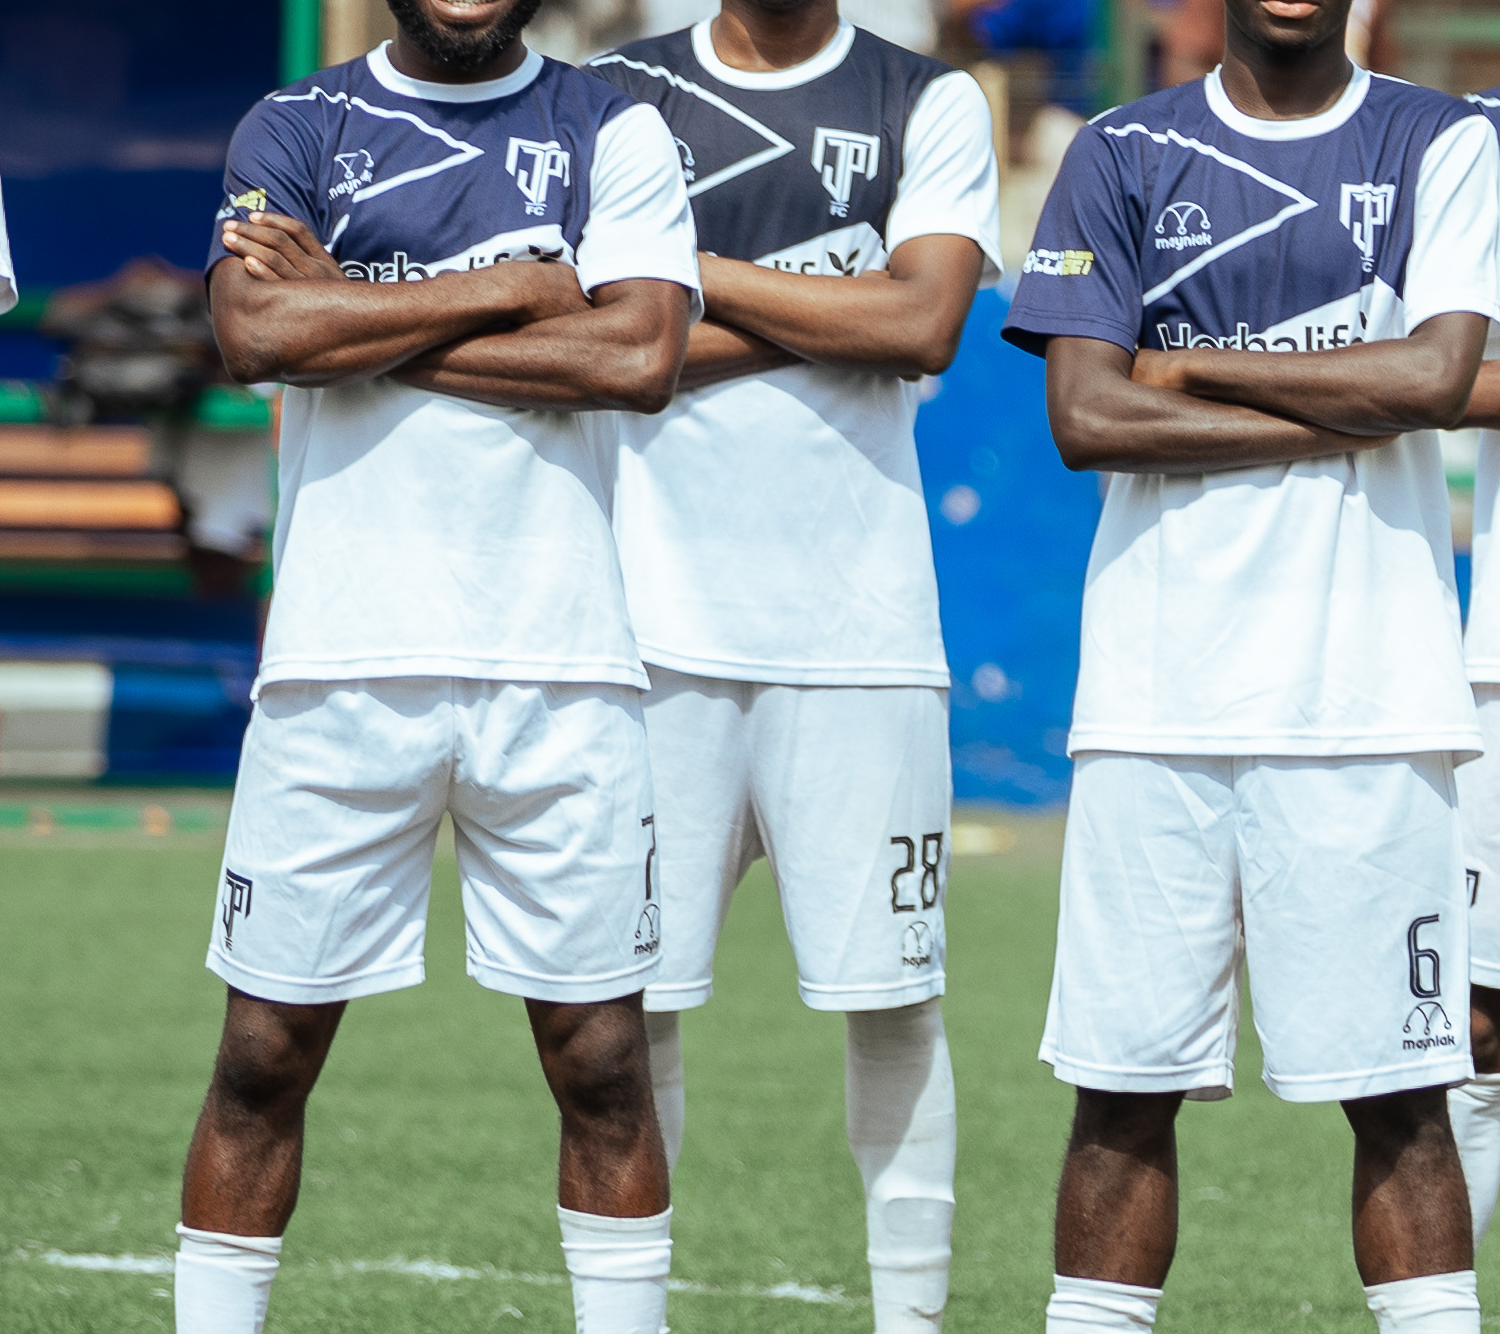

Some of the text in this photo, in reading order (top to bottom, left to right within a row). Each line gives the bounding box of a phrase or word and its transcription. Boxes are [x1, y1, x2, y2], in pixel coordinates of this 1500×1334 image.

[890, 832, 943, 913] 28
[1407, 913, 1441, 998] 6
[1402, 1034, 1456, 1051] mayniak
